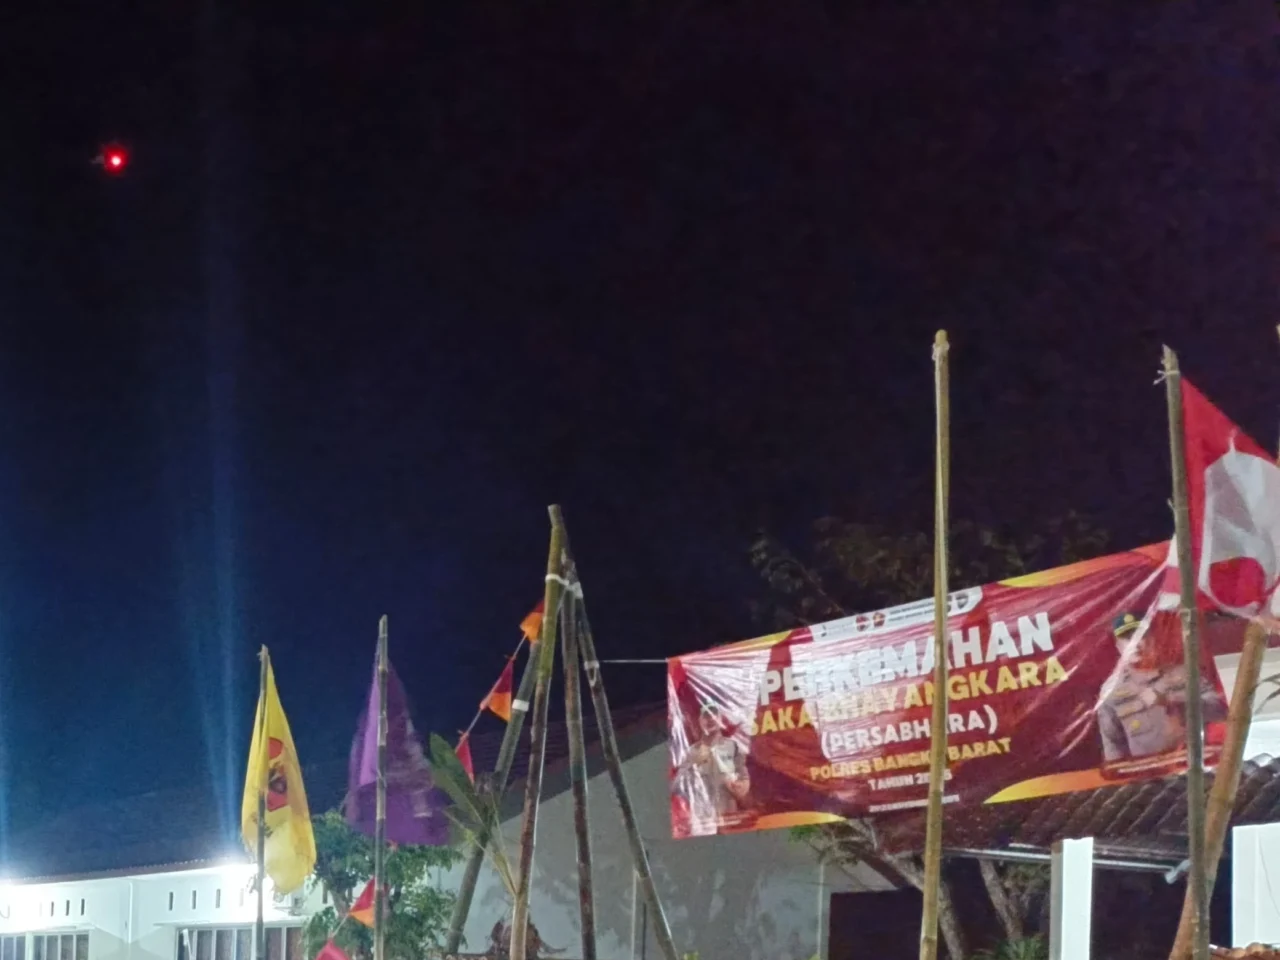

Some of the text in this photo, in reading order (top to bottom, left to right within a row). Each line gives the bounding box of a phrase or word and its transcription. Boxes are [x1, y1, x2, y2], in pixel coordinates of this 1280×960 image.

[821, 704, 998, 759] (PERSABHRA)
[810, 737, 1011, 780] POLRES BANGK BARAT
[868, 774, 914, 791] TAHUN
